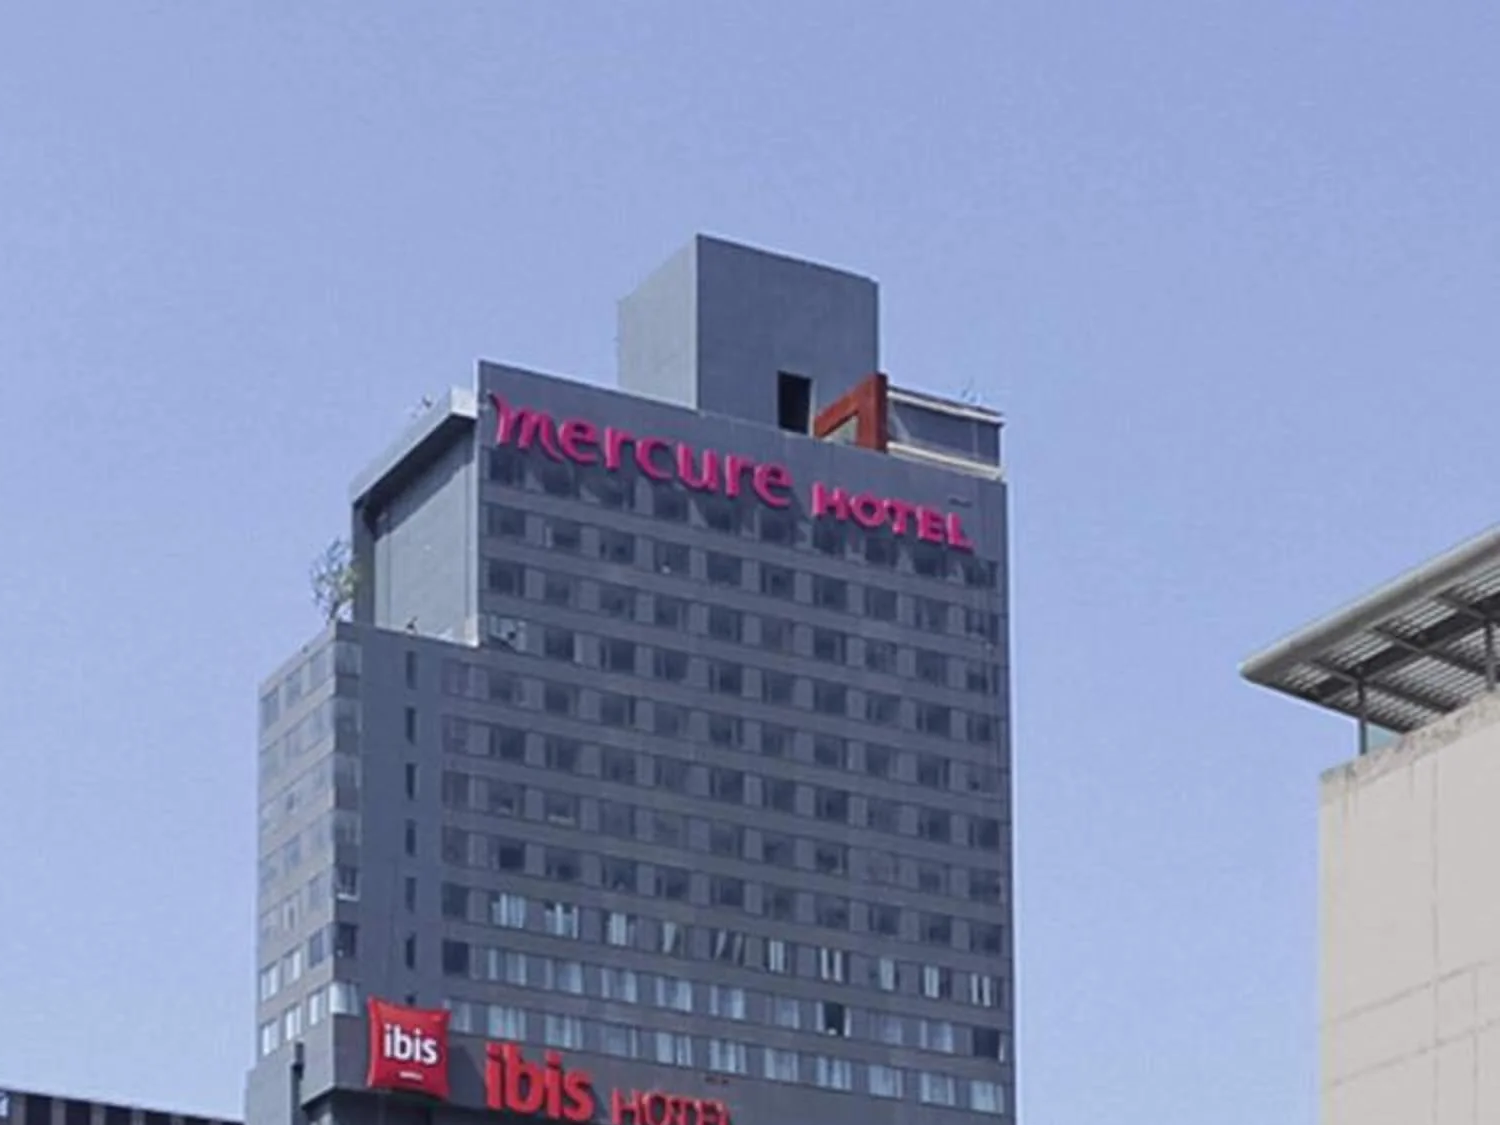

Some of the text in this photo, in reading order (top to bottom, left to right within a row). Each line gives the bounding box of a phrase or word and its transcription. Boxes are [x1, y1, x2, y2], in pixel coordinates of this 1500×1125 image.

[811, 480, 975, 553] HOTEL
[383, 1023, 438, 1066] ibis
[484, 1041, 594, 1122] ibis
